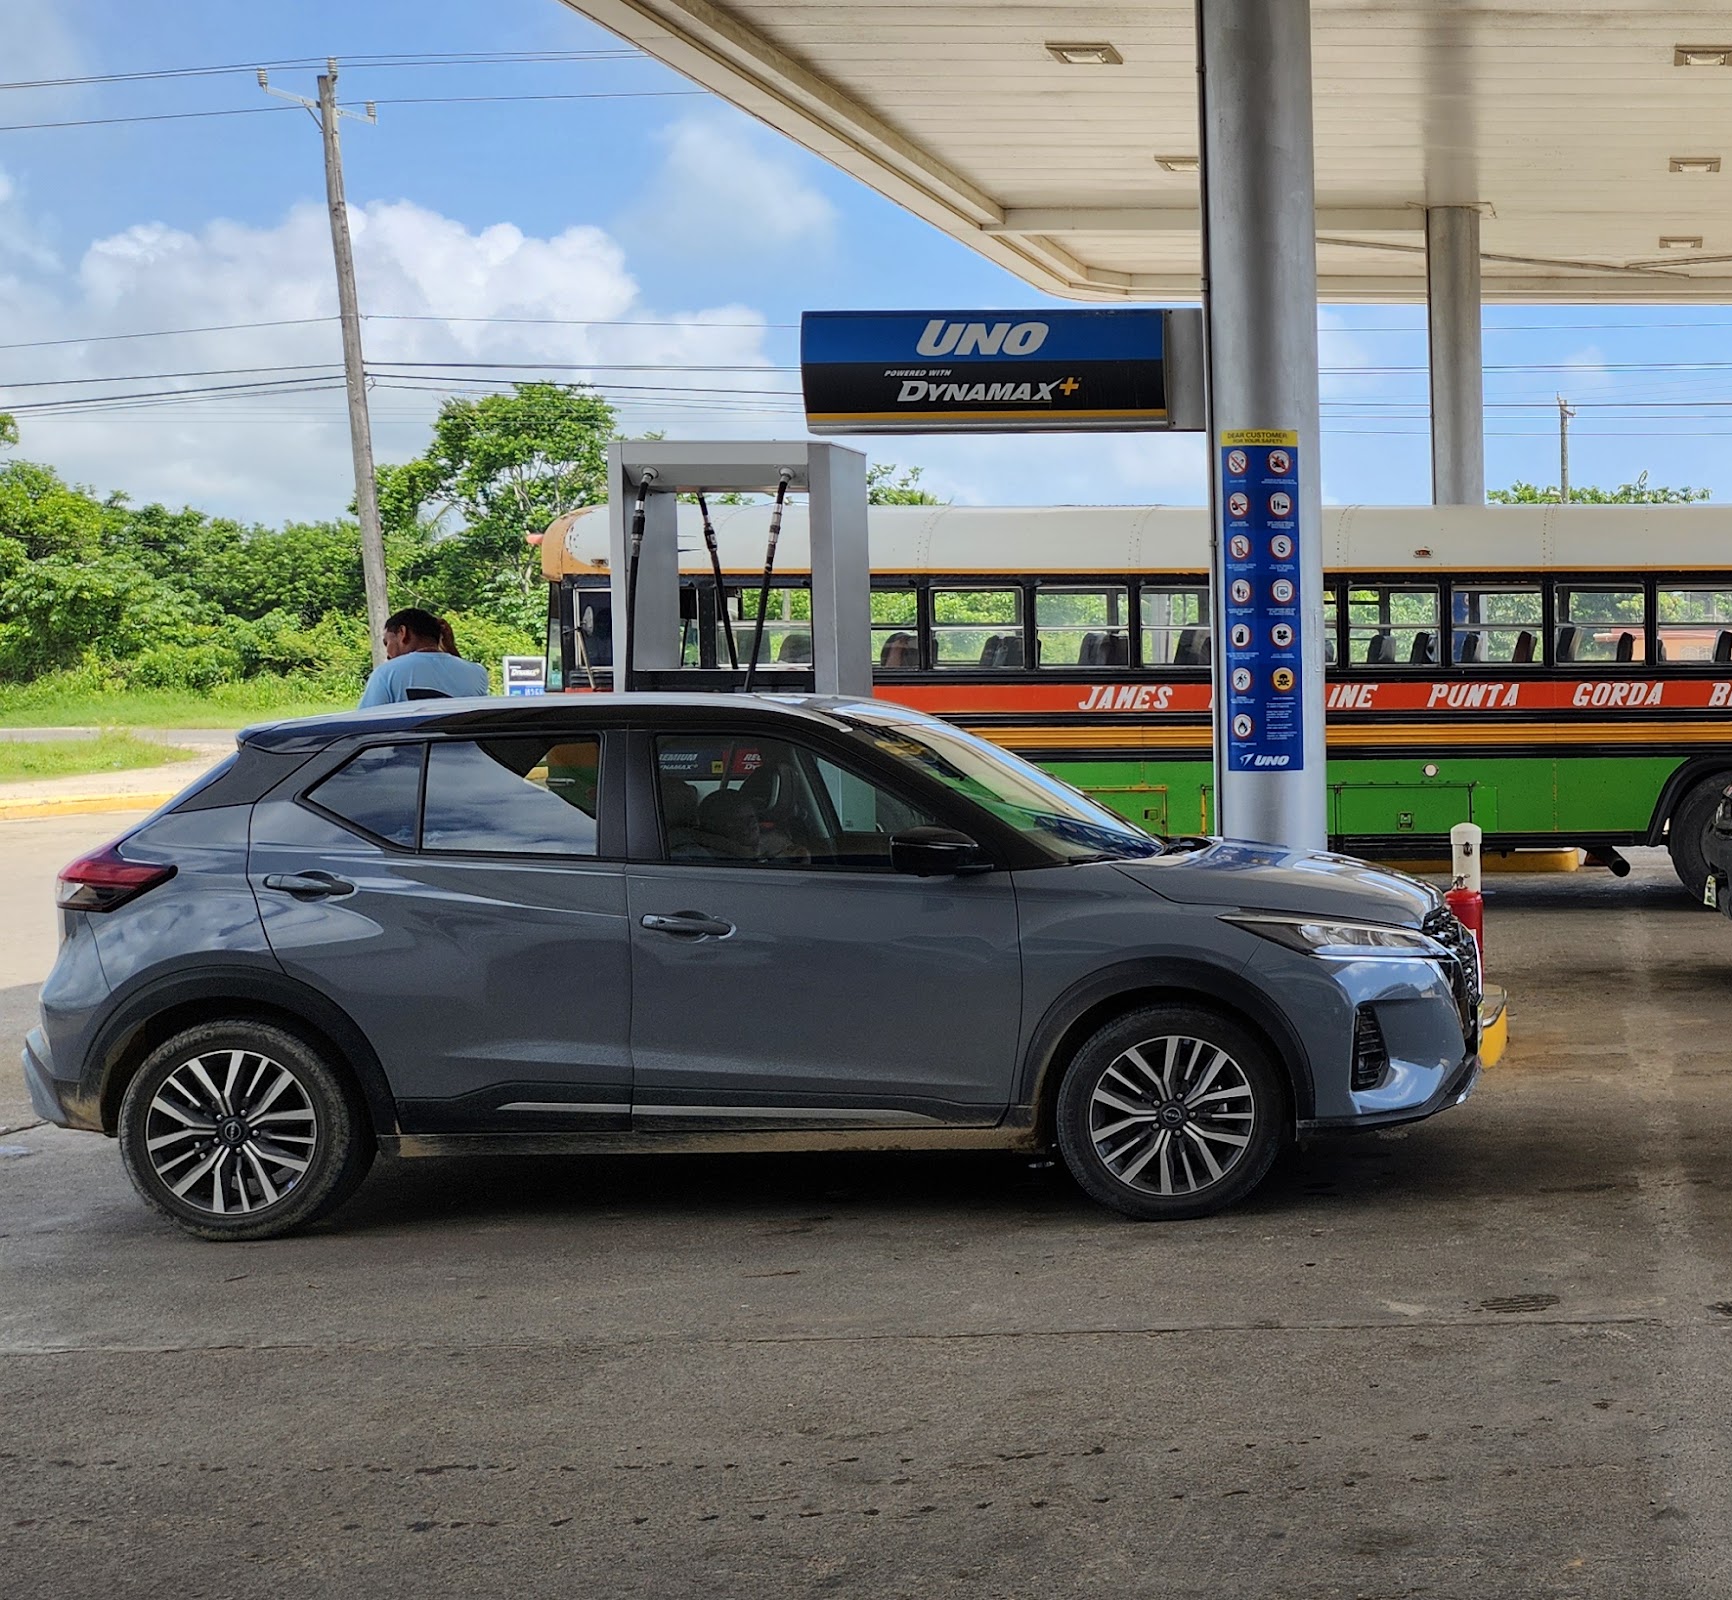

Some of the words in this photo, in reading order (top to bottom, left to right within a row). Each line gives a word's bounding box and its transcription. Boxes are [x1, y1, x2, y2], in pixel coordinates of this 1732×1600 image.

[916, 319, 1050, 357] UNO
[884, 369, 927, 377] POWERED
[928, 369, 952, 377] WITH
[1078, 685, 1174, 710] JAMES
[1327, 684, 1379, 708] INE
[1426, 683, 1520, 708] PUNTA
[1572, 682, 1665, 707] GORDA
[659, 753, 698, 761] EMIUM
[1254, 754, 1290, 767] UNO
